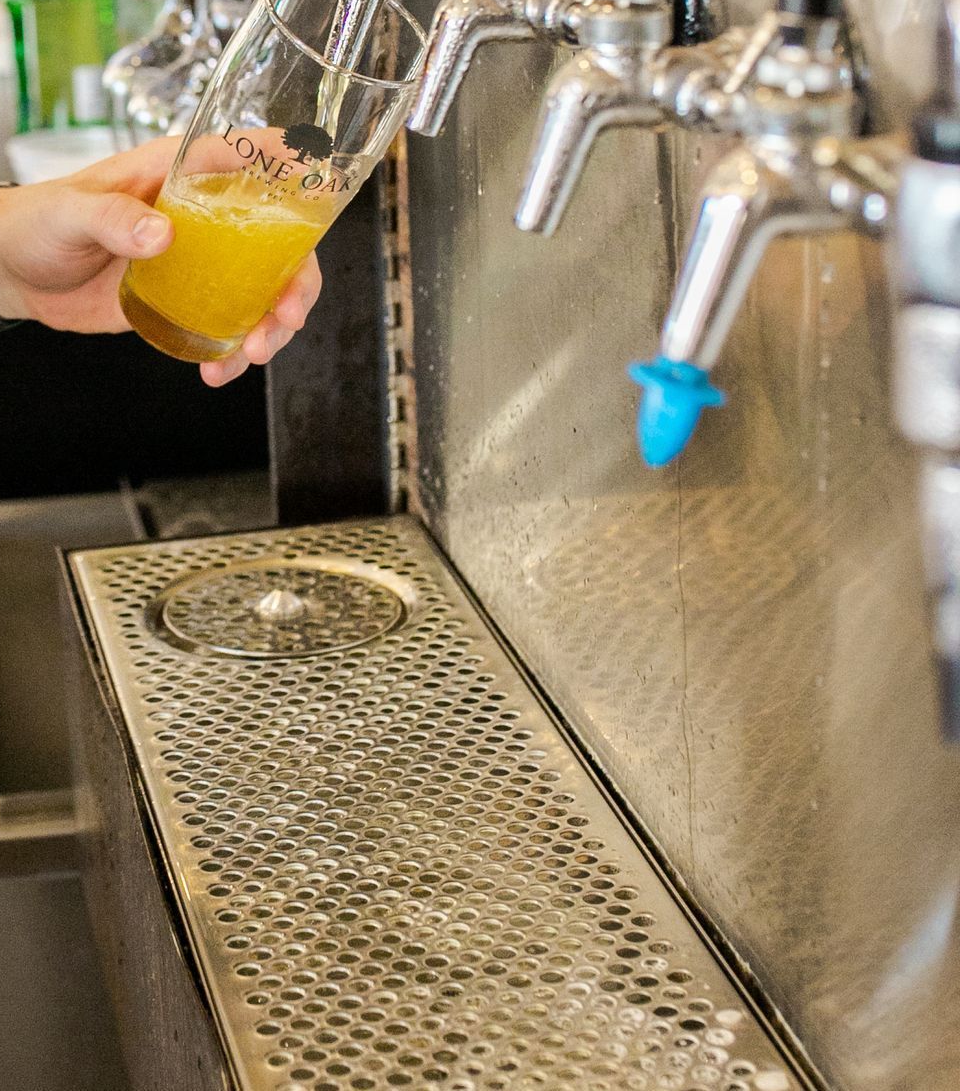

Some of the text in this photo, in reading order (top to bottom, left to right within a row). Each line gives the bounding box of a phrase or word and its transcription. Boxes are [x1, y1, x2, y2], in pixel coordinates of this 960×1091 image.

[222, 123, 353, 193] LONE OAK
[241, 165, 297, 196] BREWING
